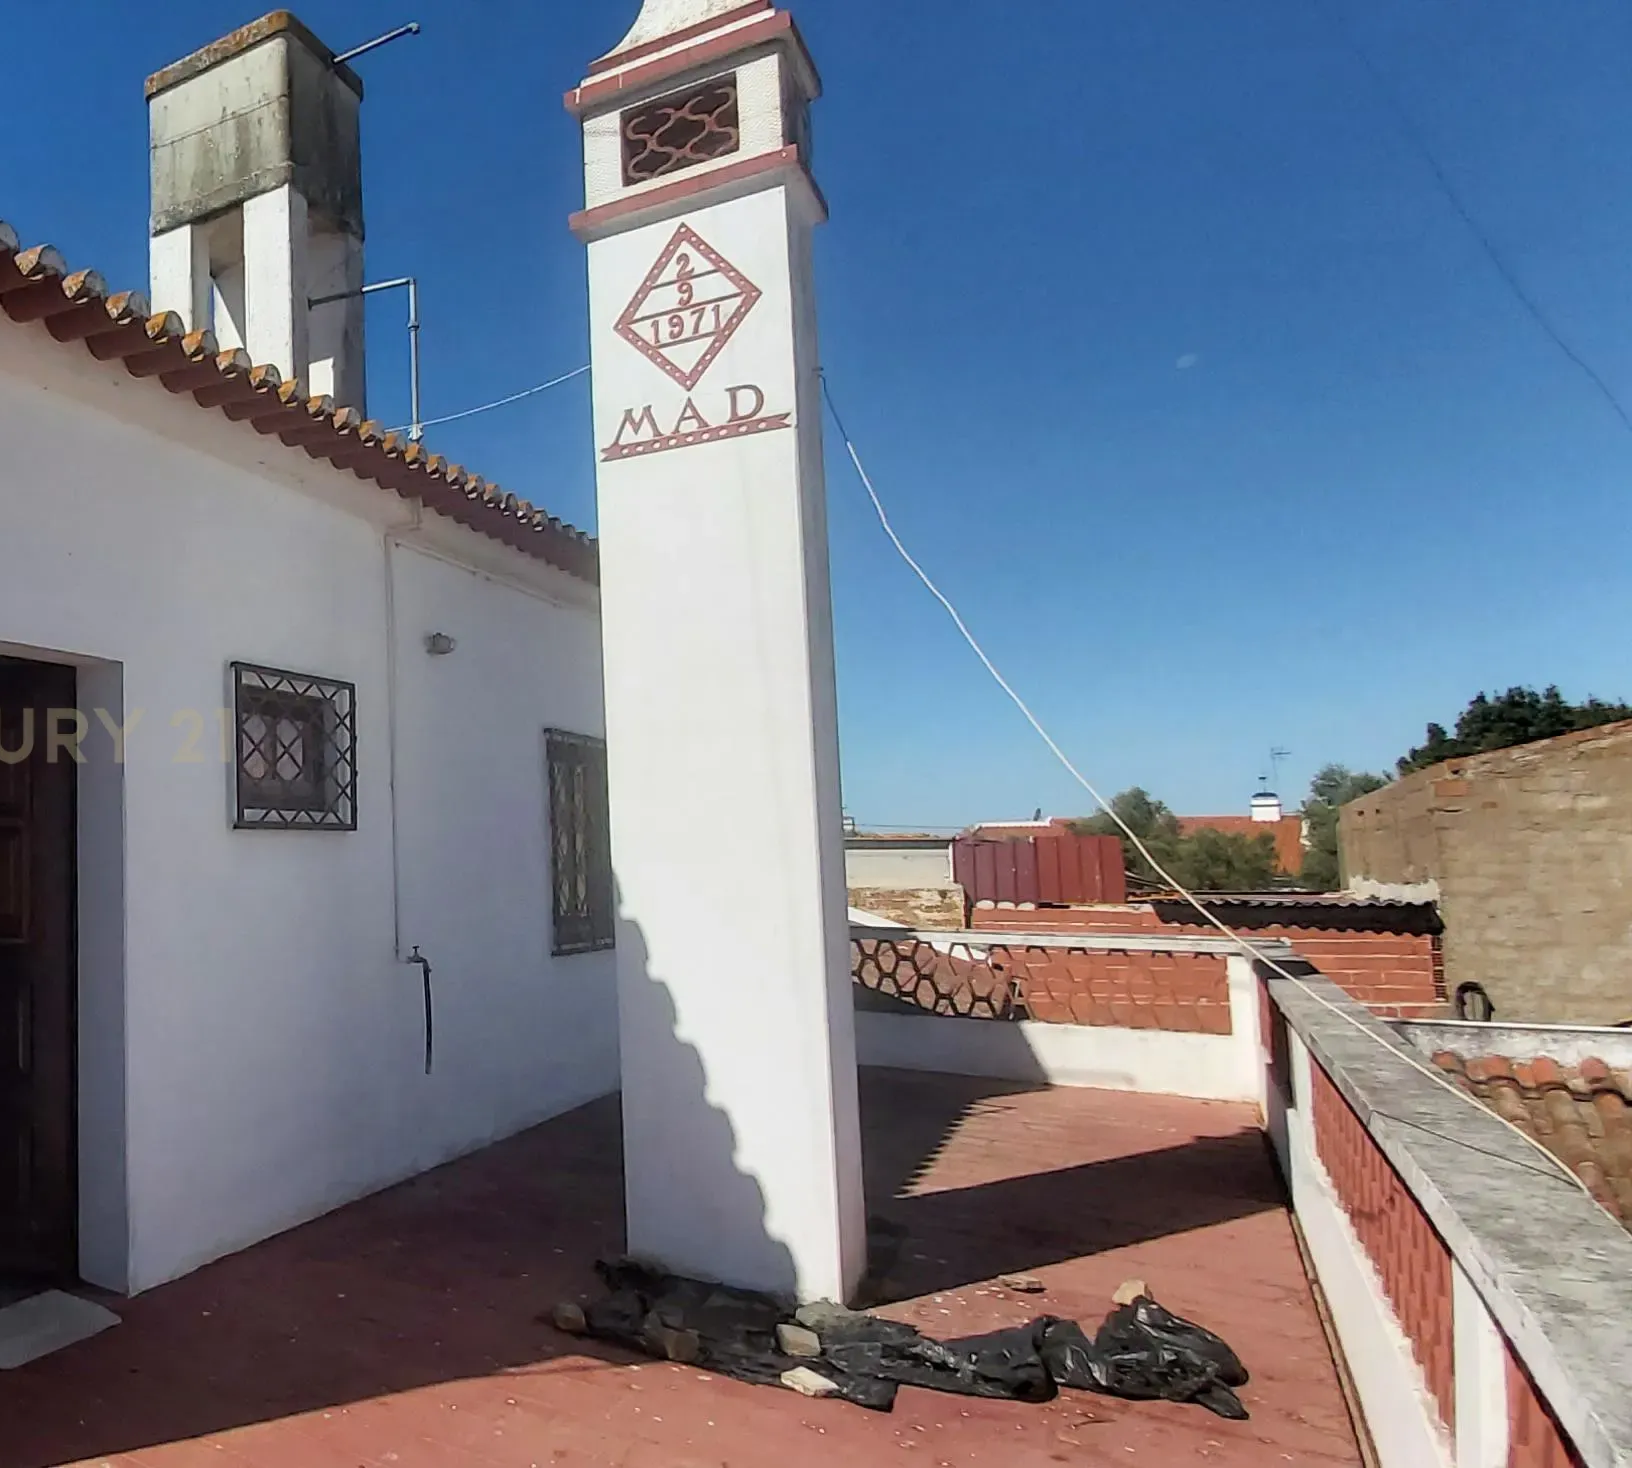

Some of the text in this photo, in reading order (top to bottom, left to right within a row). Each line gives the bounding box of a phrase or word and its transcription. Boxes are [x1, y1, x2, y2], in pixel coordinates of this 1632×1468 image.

[676, 253, 695, 279] 2
[677, 282, 693, 305] 9
[651, 304, 721, 344] 1971
[613, 385, 764, 445] MAD
